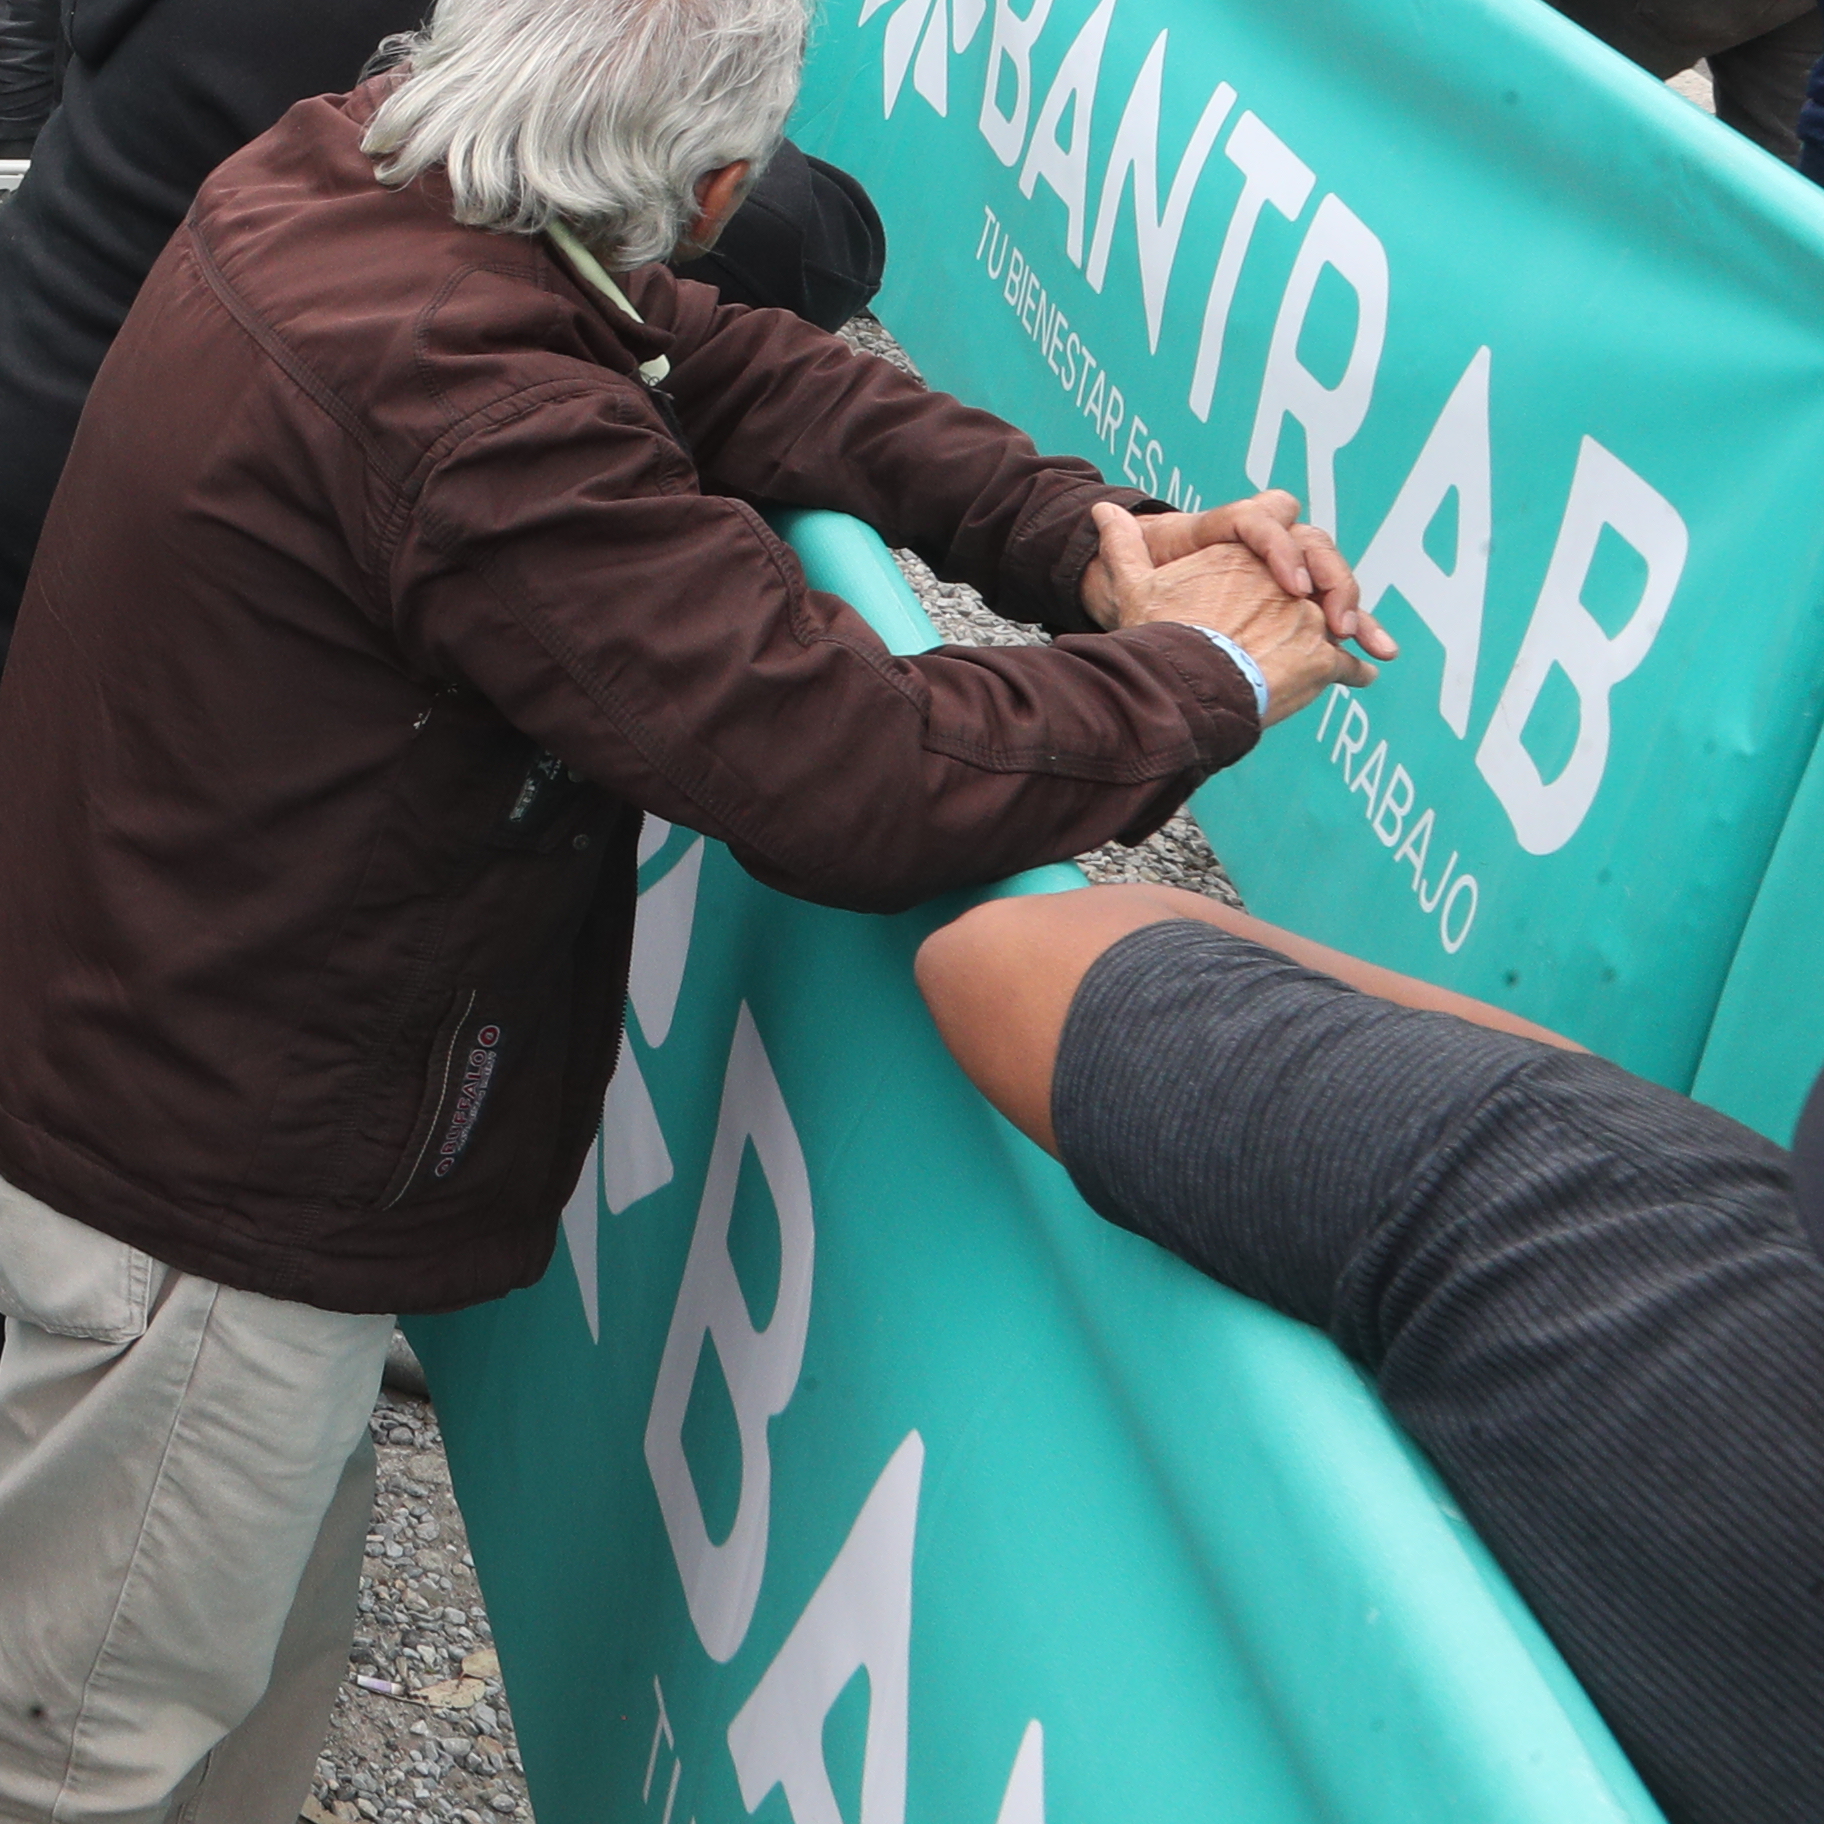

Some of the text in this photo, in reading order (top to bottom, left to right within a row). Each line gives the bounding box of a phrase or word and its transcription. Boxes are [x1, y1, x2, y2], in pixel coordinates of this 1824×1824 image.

[976, 204, 1479, 954] TU BIENESTAR ES TRABAJO
[440, 1048, 487, 1157] BUFFALO
